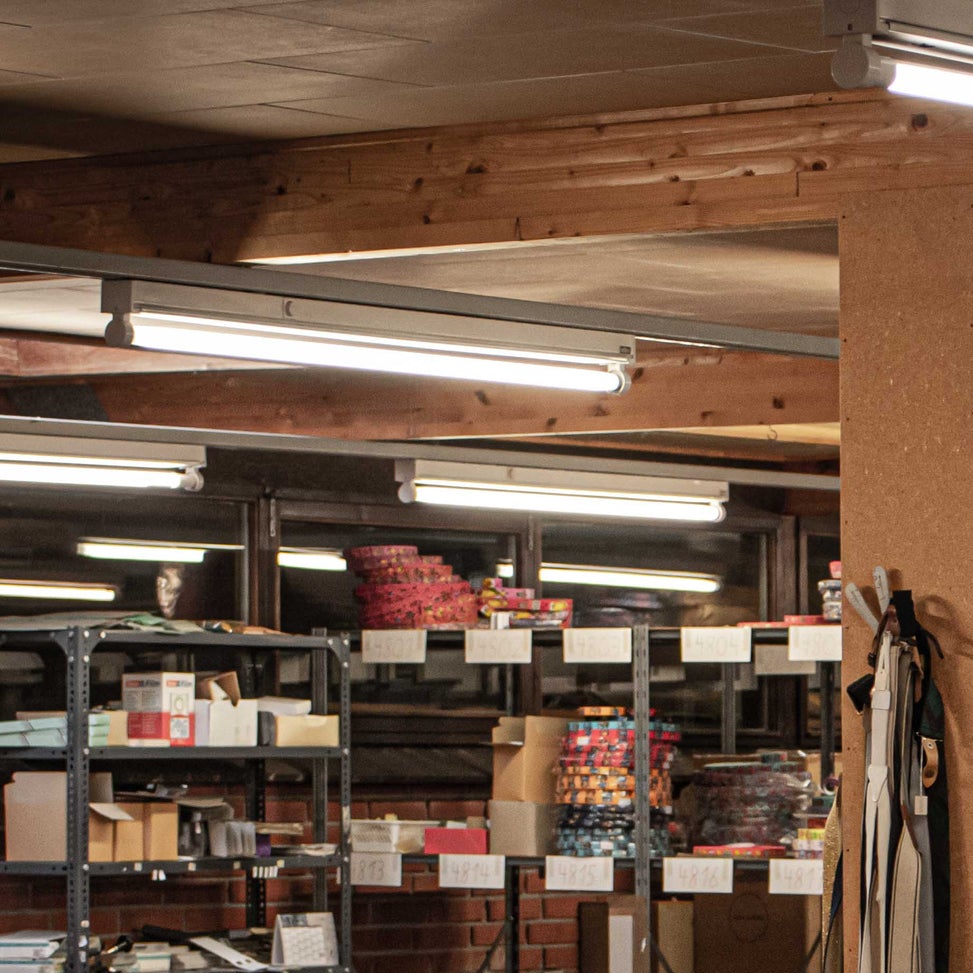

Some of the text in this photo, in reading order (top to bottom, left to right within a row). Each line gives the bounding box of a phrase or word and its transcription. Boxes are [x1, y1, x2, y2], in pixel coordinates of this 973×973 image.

[350, 860, 385, 881] 813
[452, 861, 488, 884] 4814
[558, 863, 597, 887] 4815
[679, 863, 719, 888] 4816
